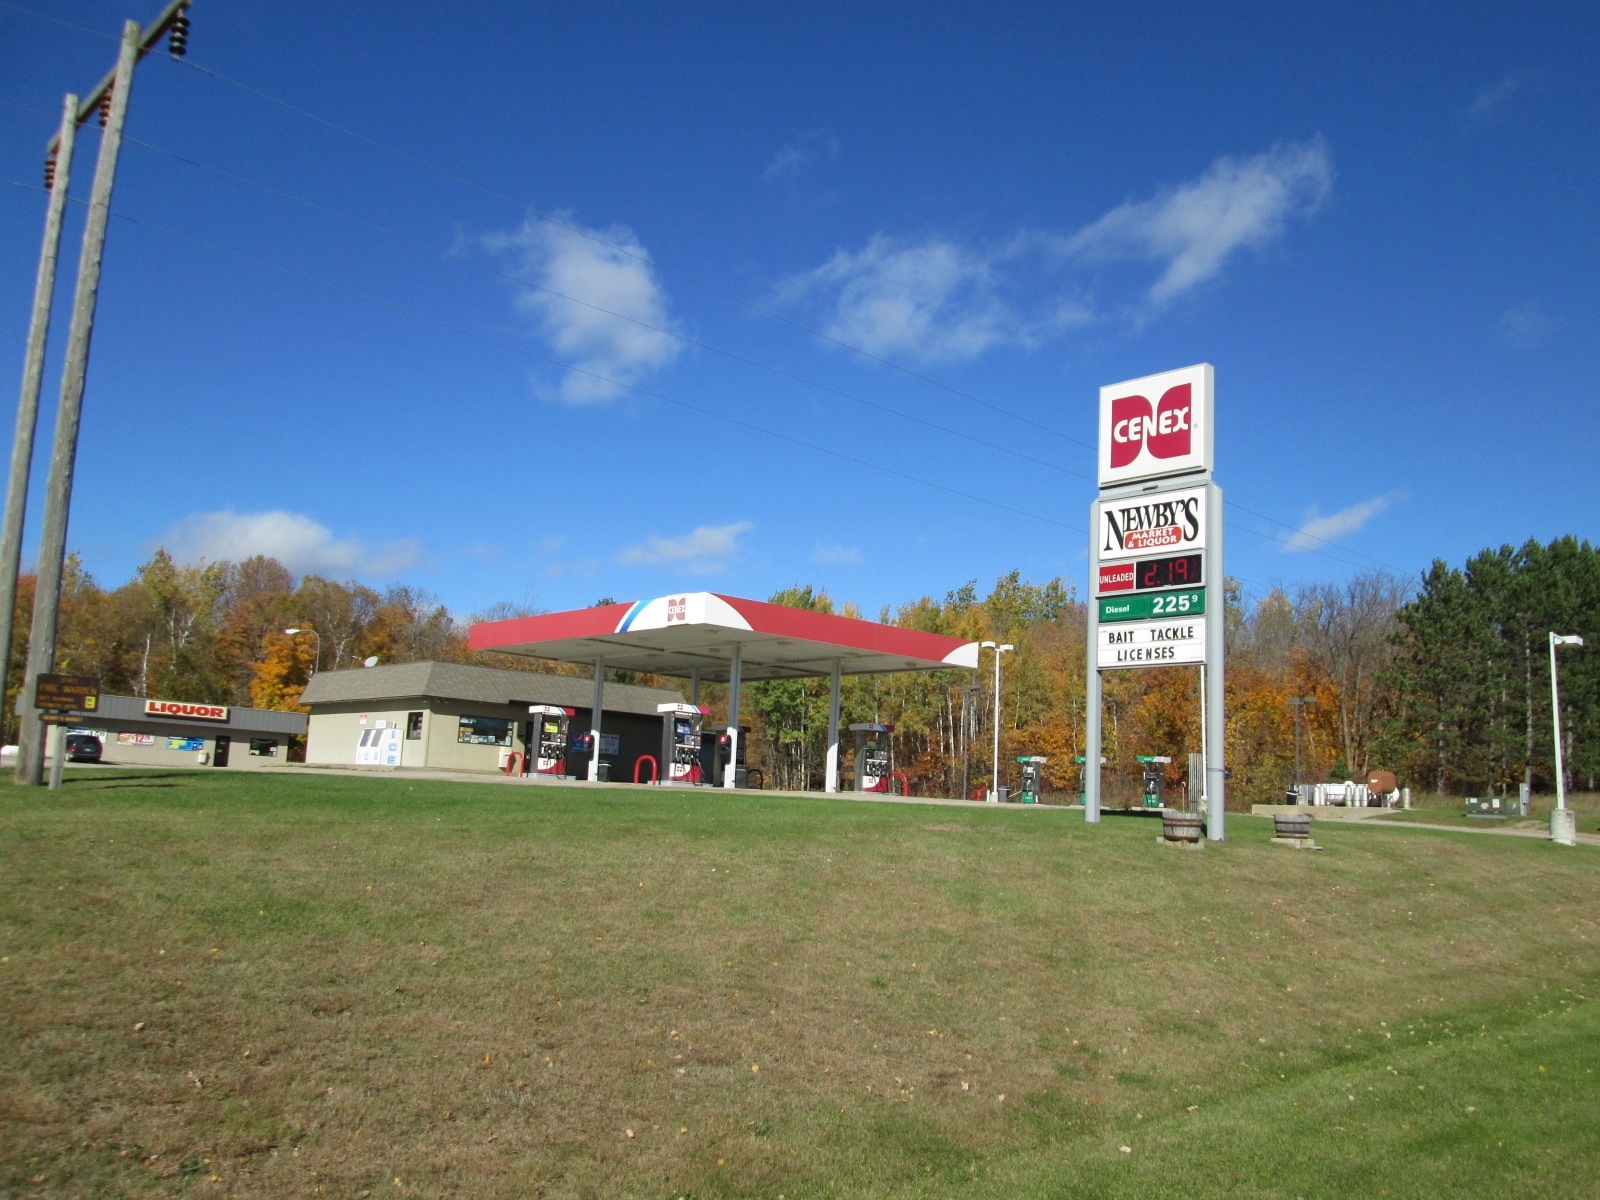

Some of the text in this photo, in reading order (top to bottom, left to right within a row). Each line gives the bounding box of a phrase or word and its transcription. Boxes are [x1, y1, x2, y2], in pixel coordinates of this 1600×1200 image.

[1113, 406, 1189, 443] CENEX
[1103, 497, 1199, 551] NEWBY'S
[1127, 534, 1177, 548] & LIQUOR
[1131, 527, 1174, 540] MARKET
[1099, 572, 1134, 584] UNLEADED
[1105, 604, 1130, 614] Diesel
[1108, 626, 1194, 644] BAIT TACKLE
[1117, 646, 1175, 661] LICENSES
[149, 701, 225, 718] LIQUOR
